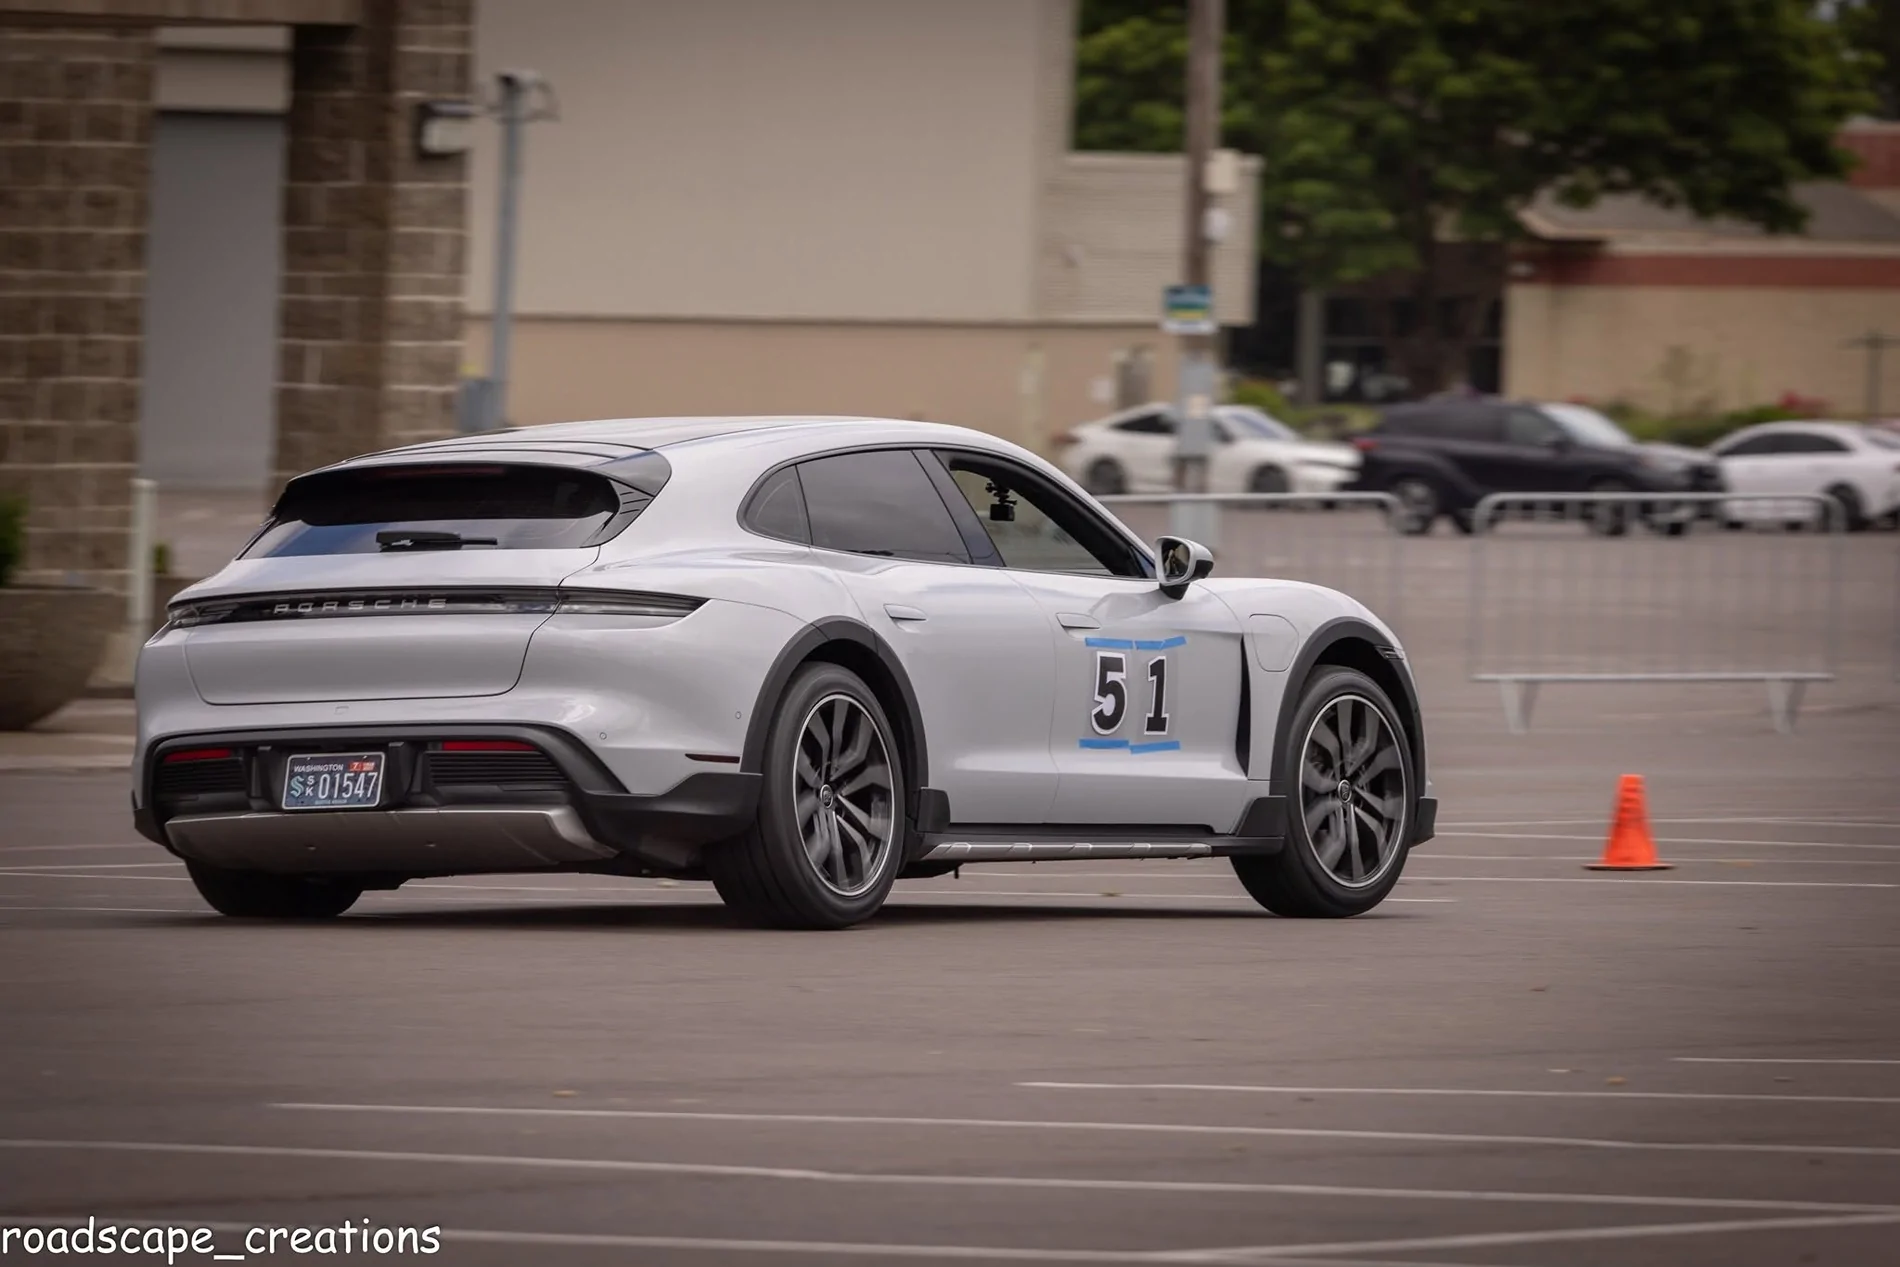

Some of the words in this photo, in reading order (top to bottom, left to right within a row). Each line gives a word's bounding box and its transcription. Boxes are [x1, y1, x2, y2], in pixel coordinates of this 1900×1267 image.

[273, 598, 447, 614] PORSCHE
[294, 764, 344, 772] WASHINGTON
[318, 772, 378, 799] 01547
